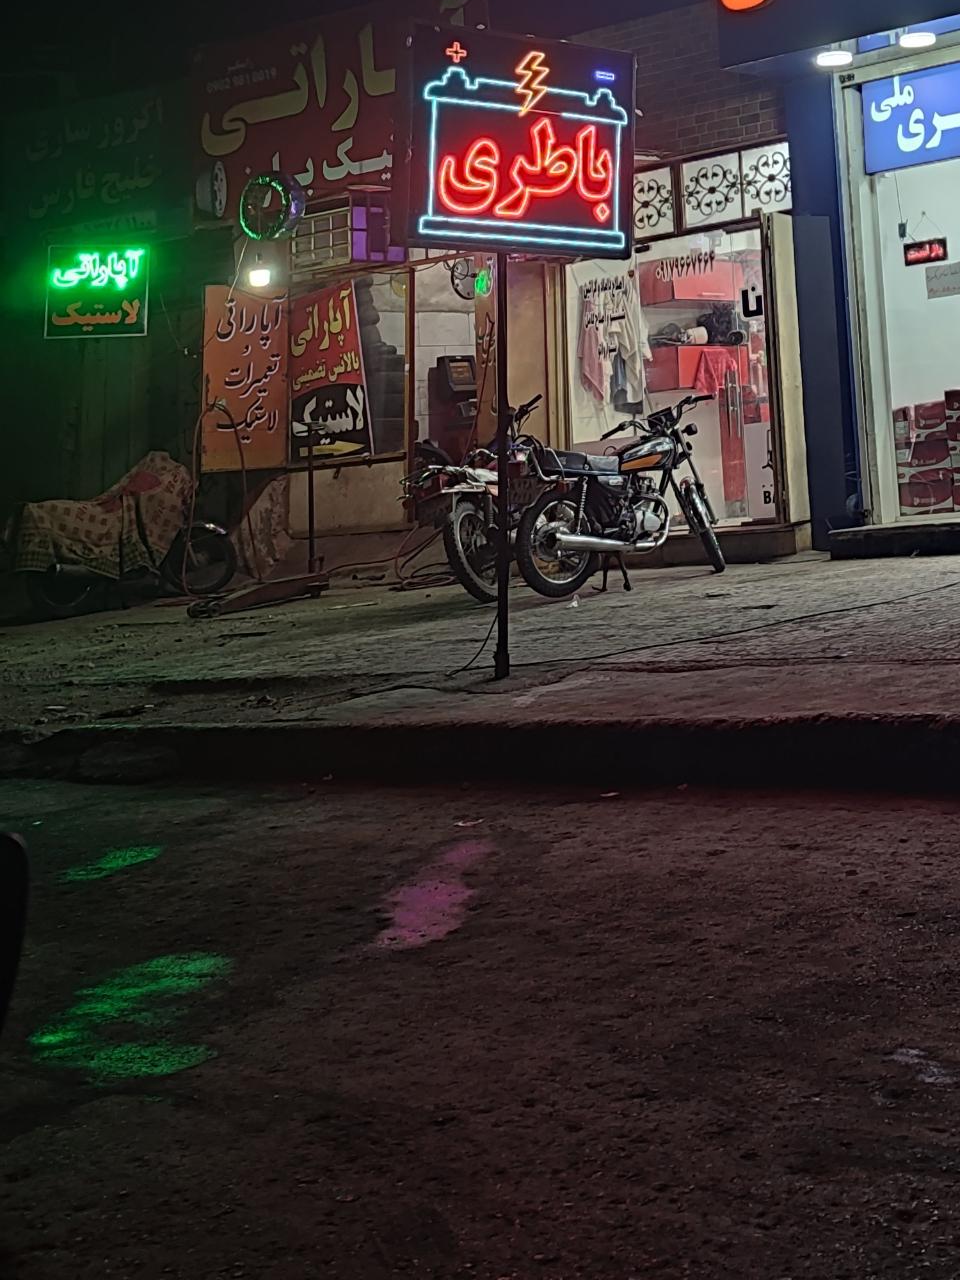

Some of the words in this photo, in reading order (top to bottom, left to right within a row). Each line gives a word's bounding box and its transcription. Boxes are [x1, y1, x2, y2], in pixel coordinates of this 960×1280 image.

[871, 75, 914, 122] ملی
[438, 117, 613, 222] باطری
[52, 299, 141, 331] لاستیک
[216, 294, 288, 350] آپاراتی
[290, 288, 352, 357] آپاراتی
[224, 352, 282, 399] تعمیرات
[292, 384, 365, 445] لاستیک
